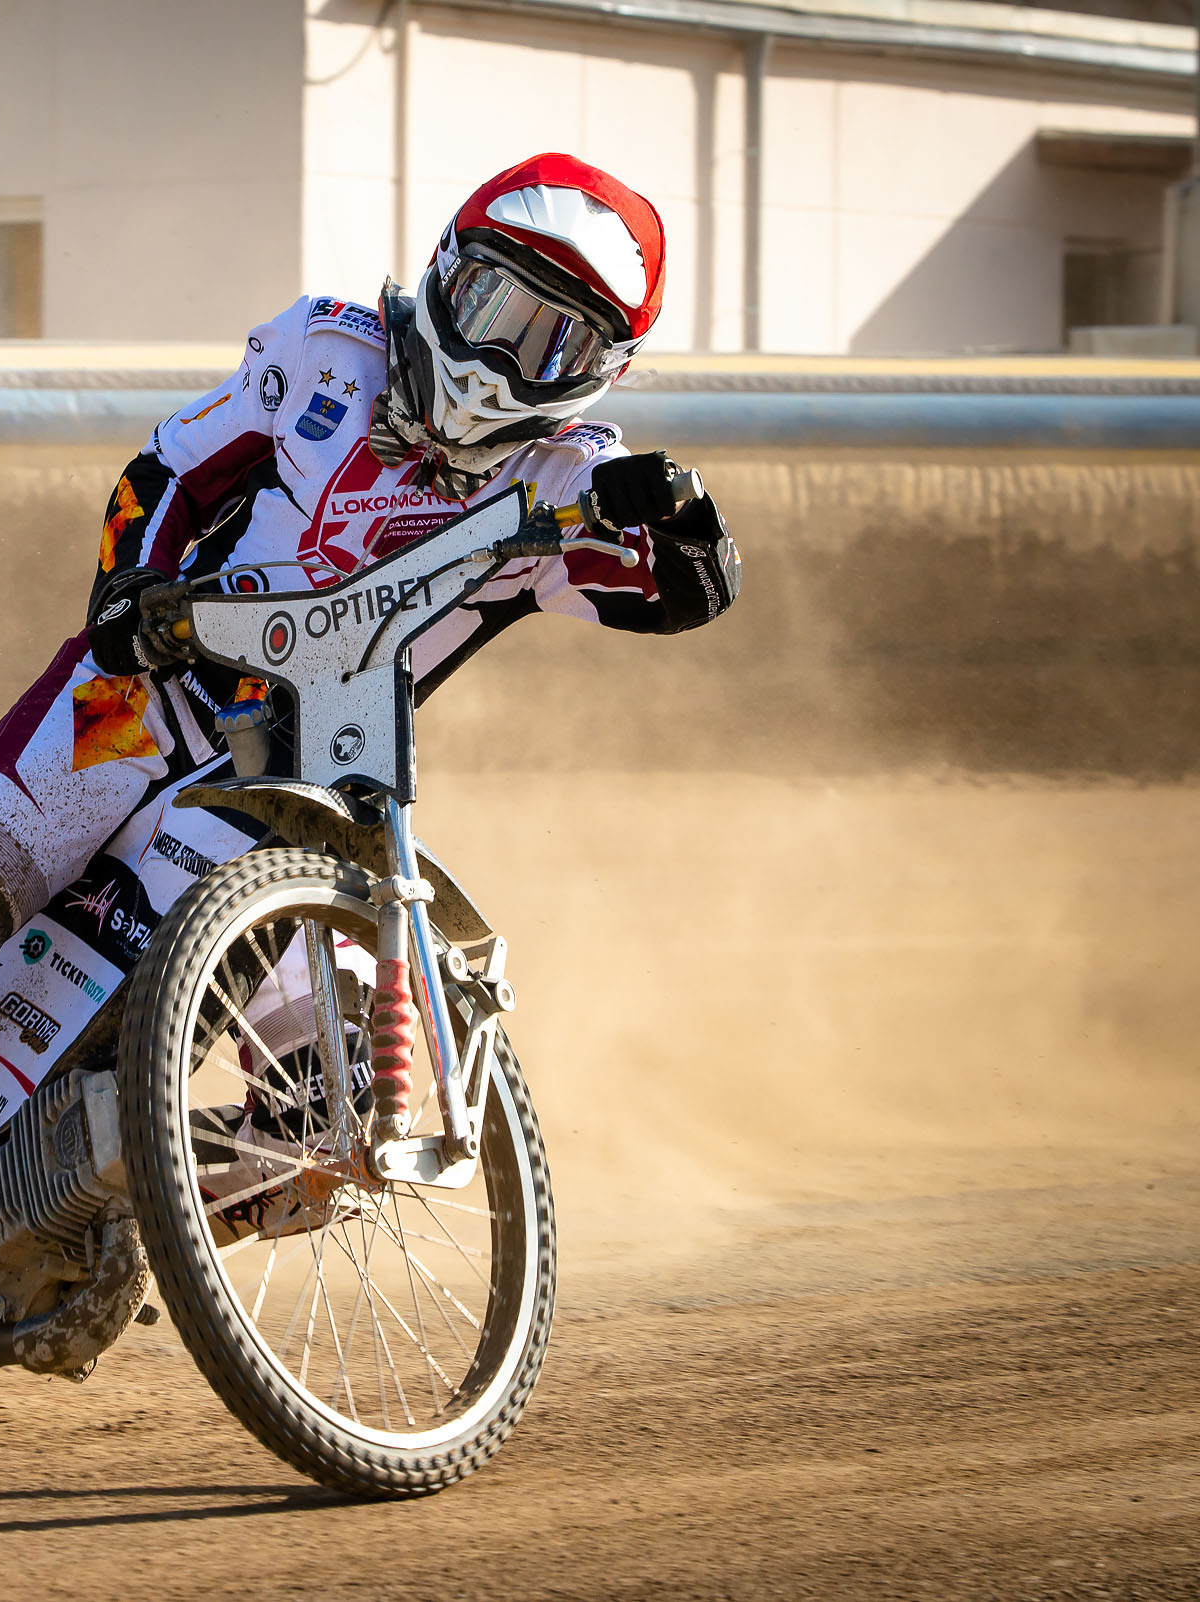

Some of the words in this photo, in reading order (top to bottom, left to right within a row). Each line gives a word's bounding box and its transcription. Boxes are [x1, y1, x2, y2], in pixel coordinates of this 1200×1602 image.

[339, 313, 386, 335] SERV
[331, 491, 452, 516] LOKOMOTI
[388, 517, 452, 530] DAUGAVPIL
[304, 574, 433, 639] OPTIBET
